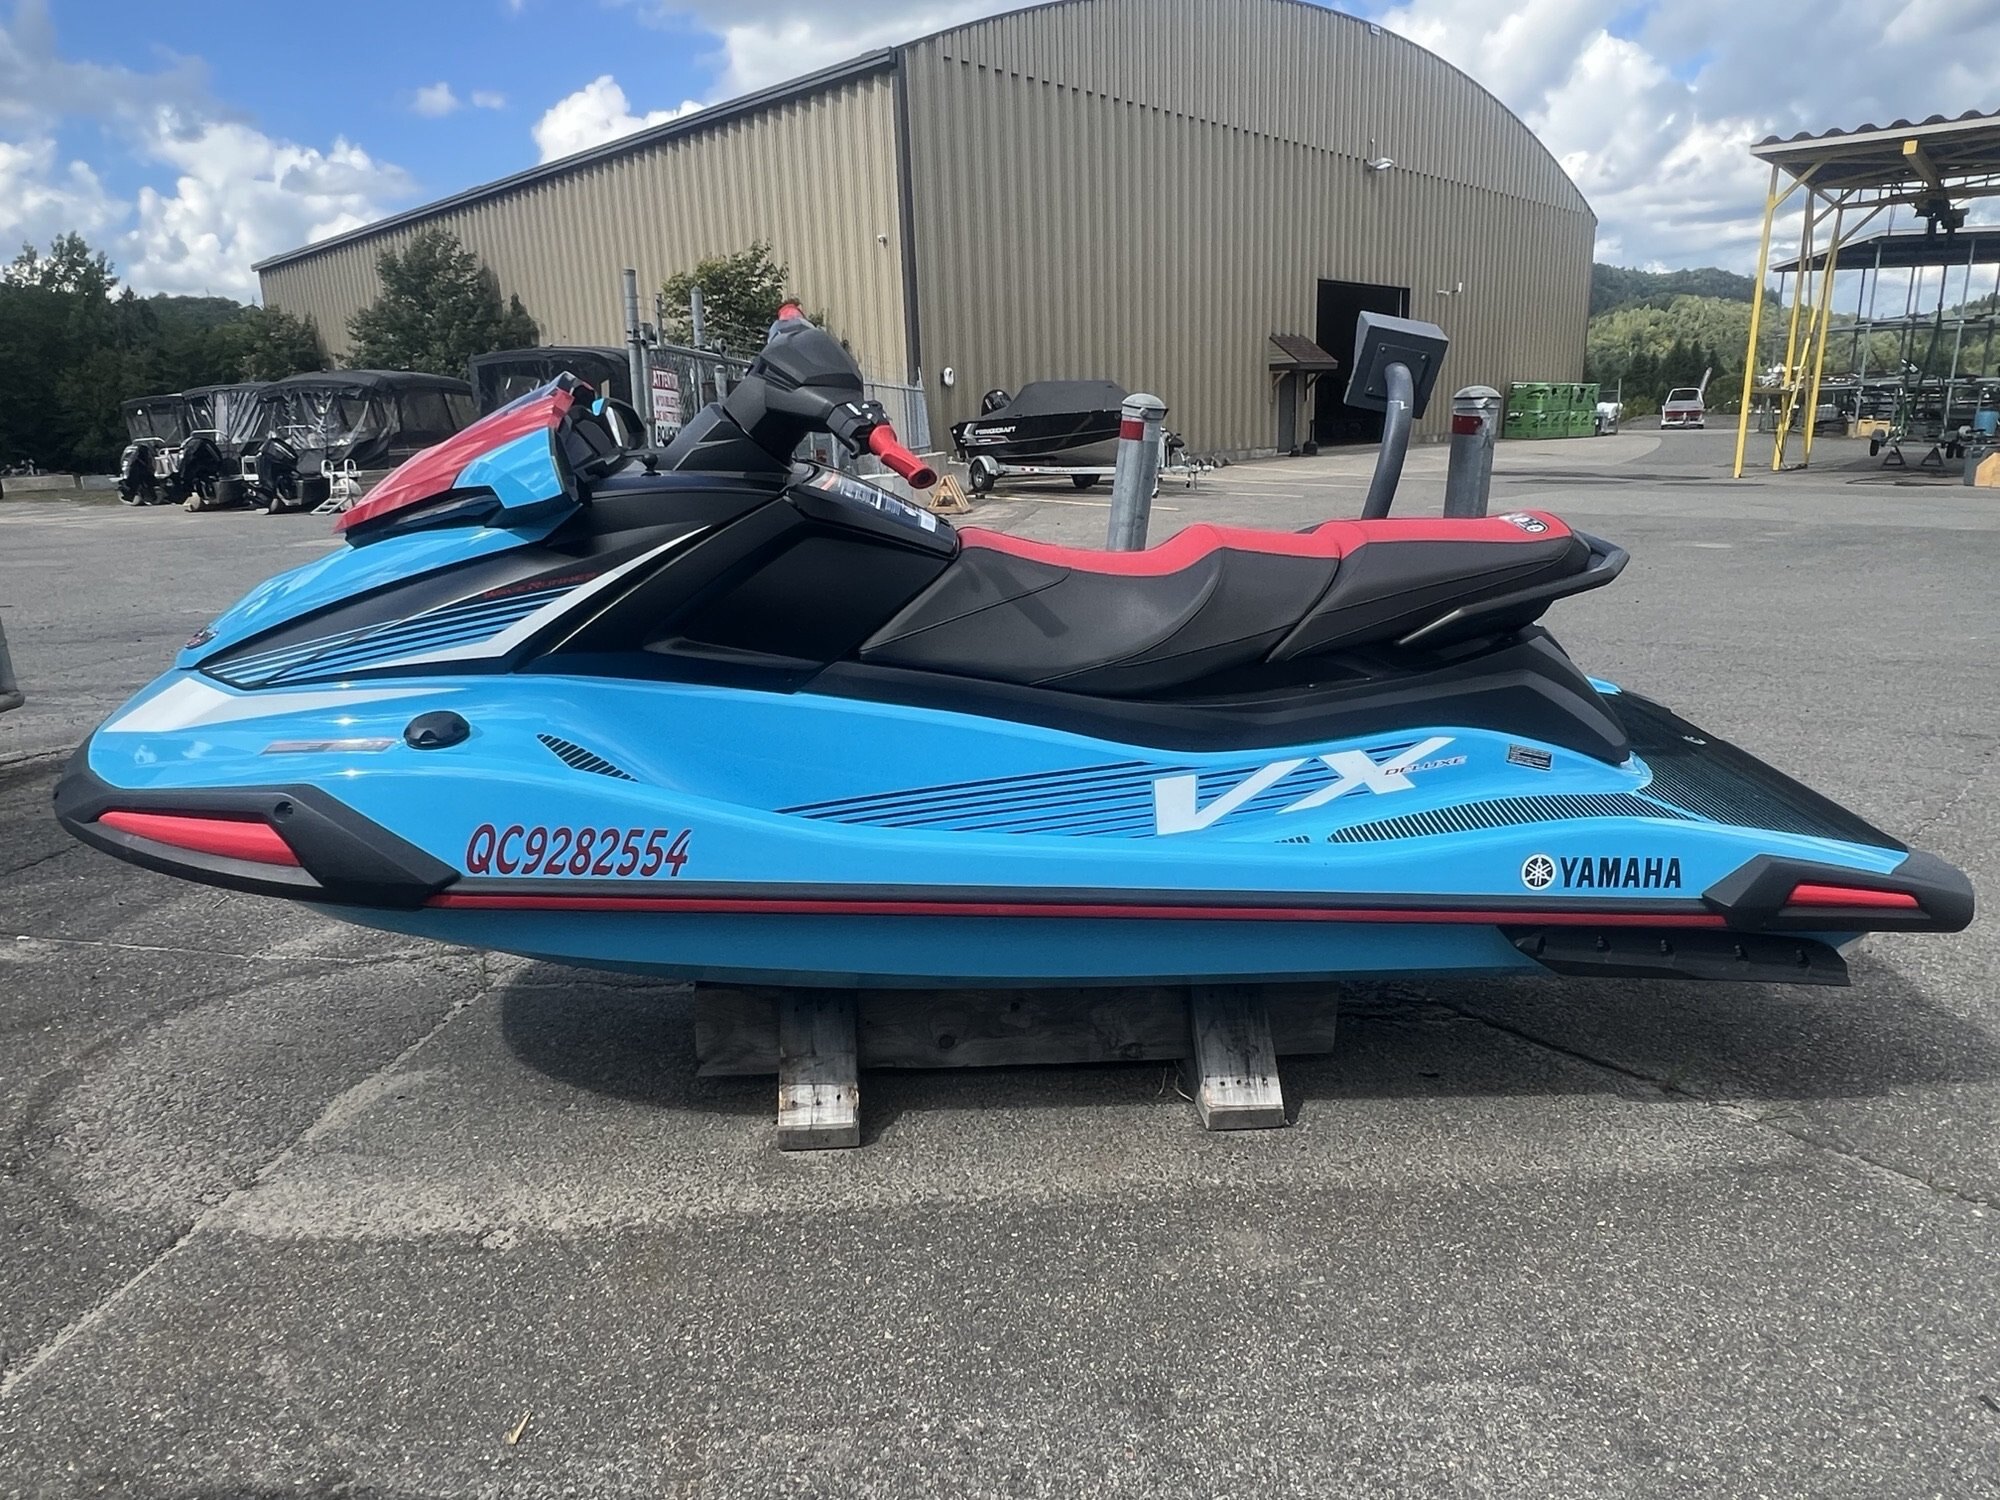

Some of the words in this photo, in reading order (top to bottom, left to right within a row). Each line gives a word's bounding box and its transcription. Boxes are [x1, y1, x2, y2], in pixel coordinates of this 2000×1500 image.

[1154, 736, 1457, 836] VX
[1384, 755, 1468, 776] DELUXE
[466, 823, 692, 877] QC9282554
[1560, 856, 1682, 889] YAMAHA
